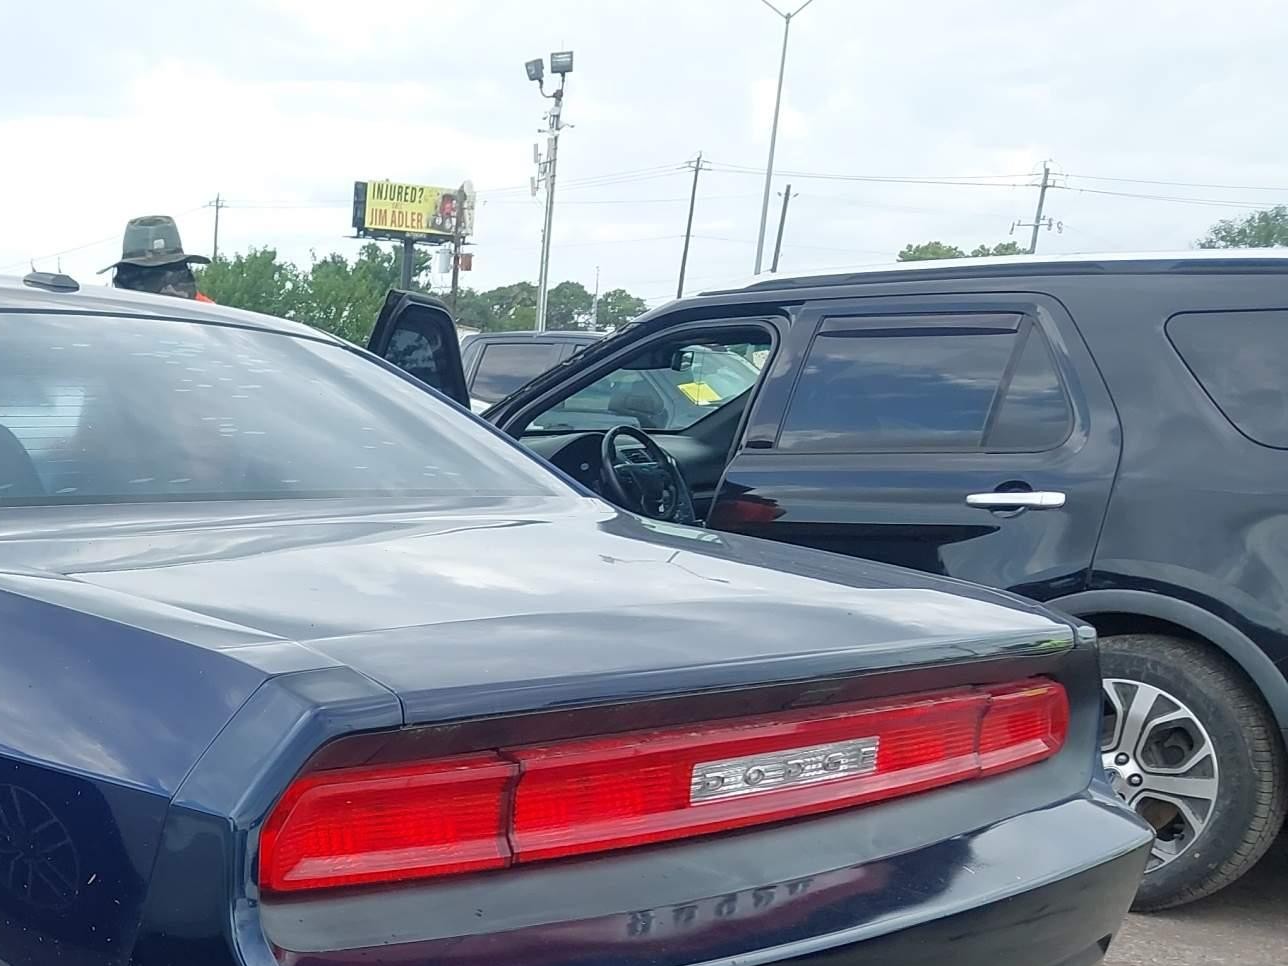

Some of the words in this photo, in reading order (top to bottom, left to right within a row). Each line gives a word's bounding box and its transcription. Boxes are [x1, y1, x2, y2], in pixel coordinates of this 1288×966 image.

[372, 183, 424, 204] INJURED?
[369, 208, 388, 227] JIM
[390, 210, 424, 230] ADLER
[702, 747, 877, 792] DODGE
